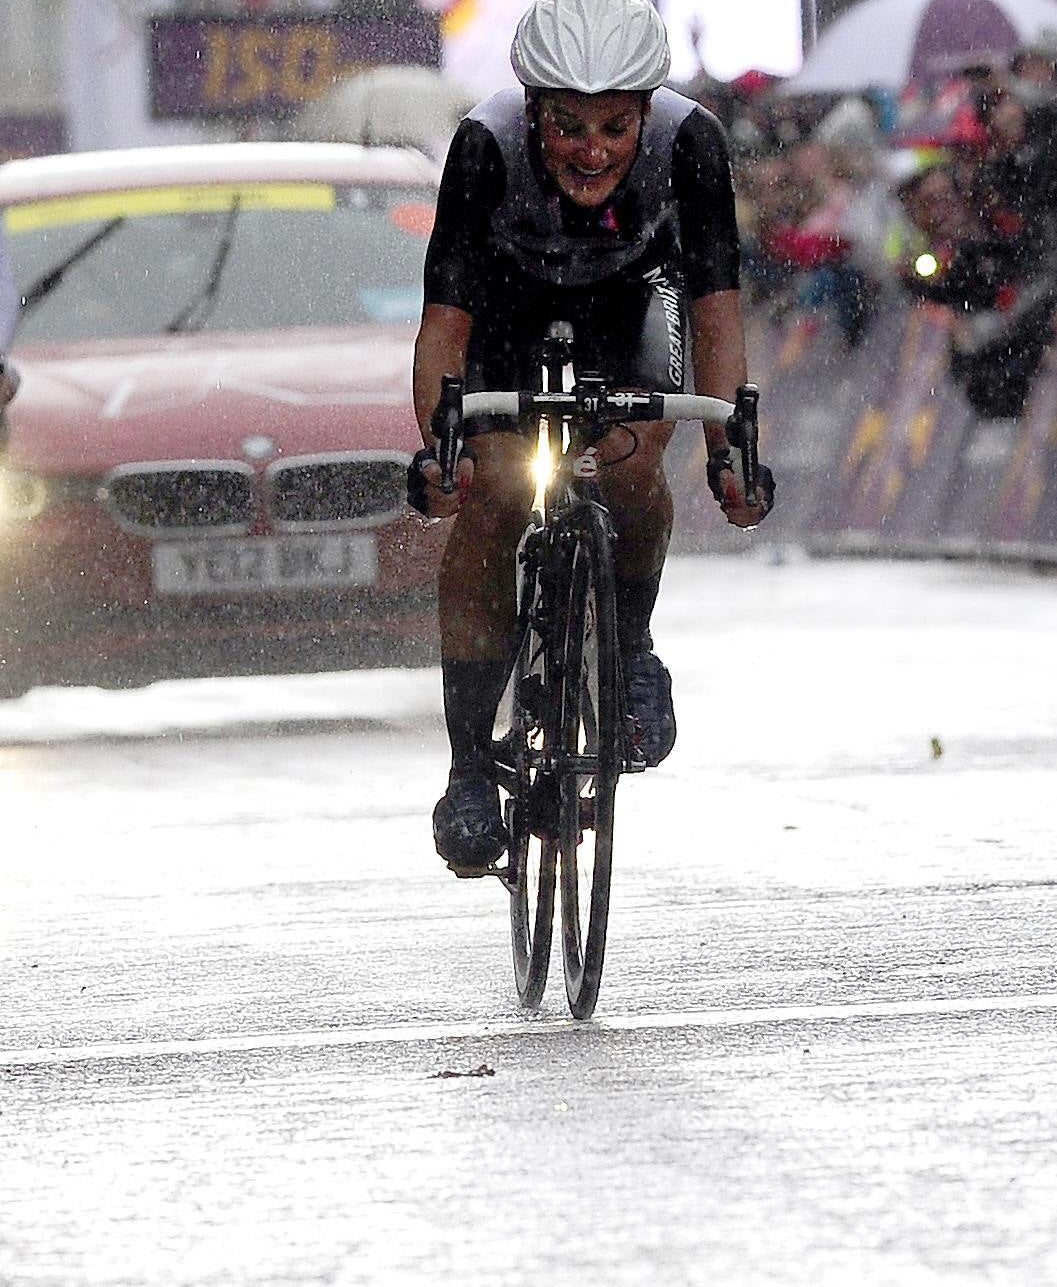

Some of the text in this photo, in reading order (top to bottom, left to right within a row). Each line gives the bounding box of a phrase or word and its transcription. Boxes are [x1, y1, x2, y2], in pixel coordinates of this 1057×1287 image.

[204, 24, 336, 103] 150
[643, 266, 683, 387] GREAT BRITN
[584, 397, 599, 412] 3T
